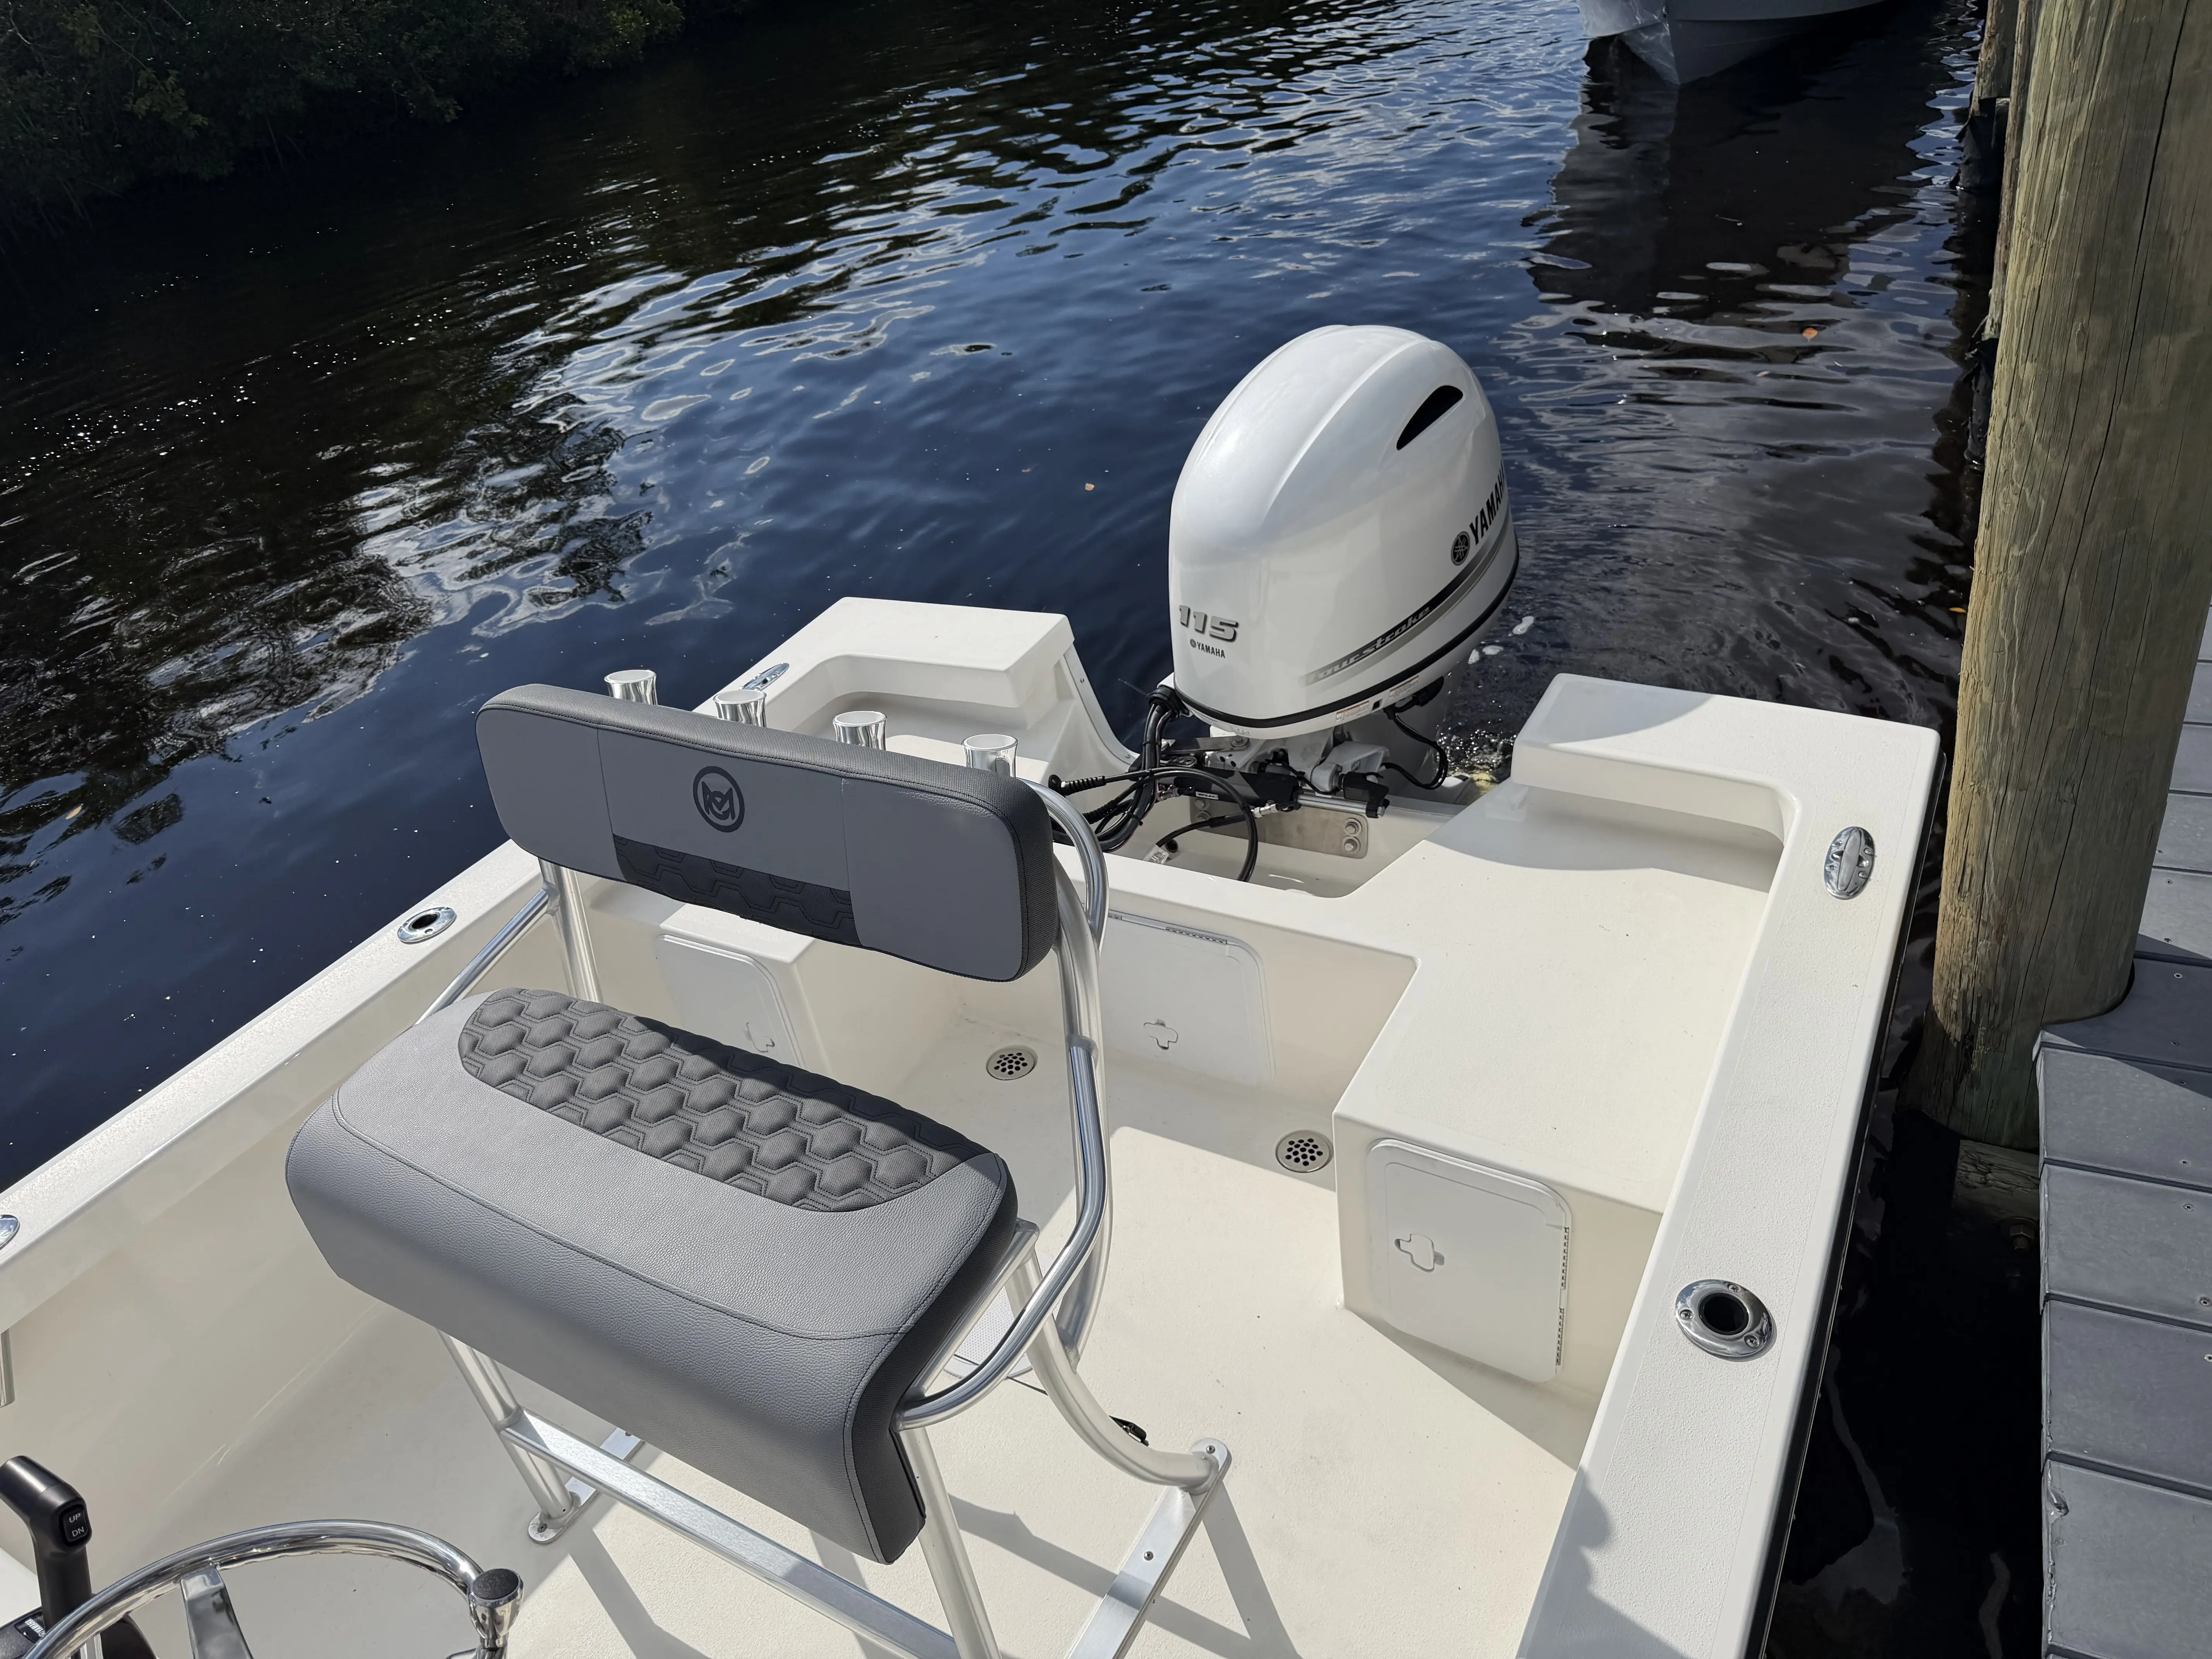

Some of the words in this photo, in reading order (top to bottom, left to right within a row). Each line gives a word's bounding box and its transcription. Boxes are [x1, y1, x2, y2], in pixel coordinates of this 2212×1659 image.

[1179, 605, 1239, 642] 115
[1197, 641, 1225, 658] YAMAHA
[69, 1513, 81, 1523] UP
[72, 1526, 84, 1537] DN
[24, 1618, 44, 1634] YAMAHA
